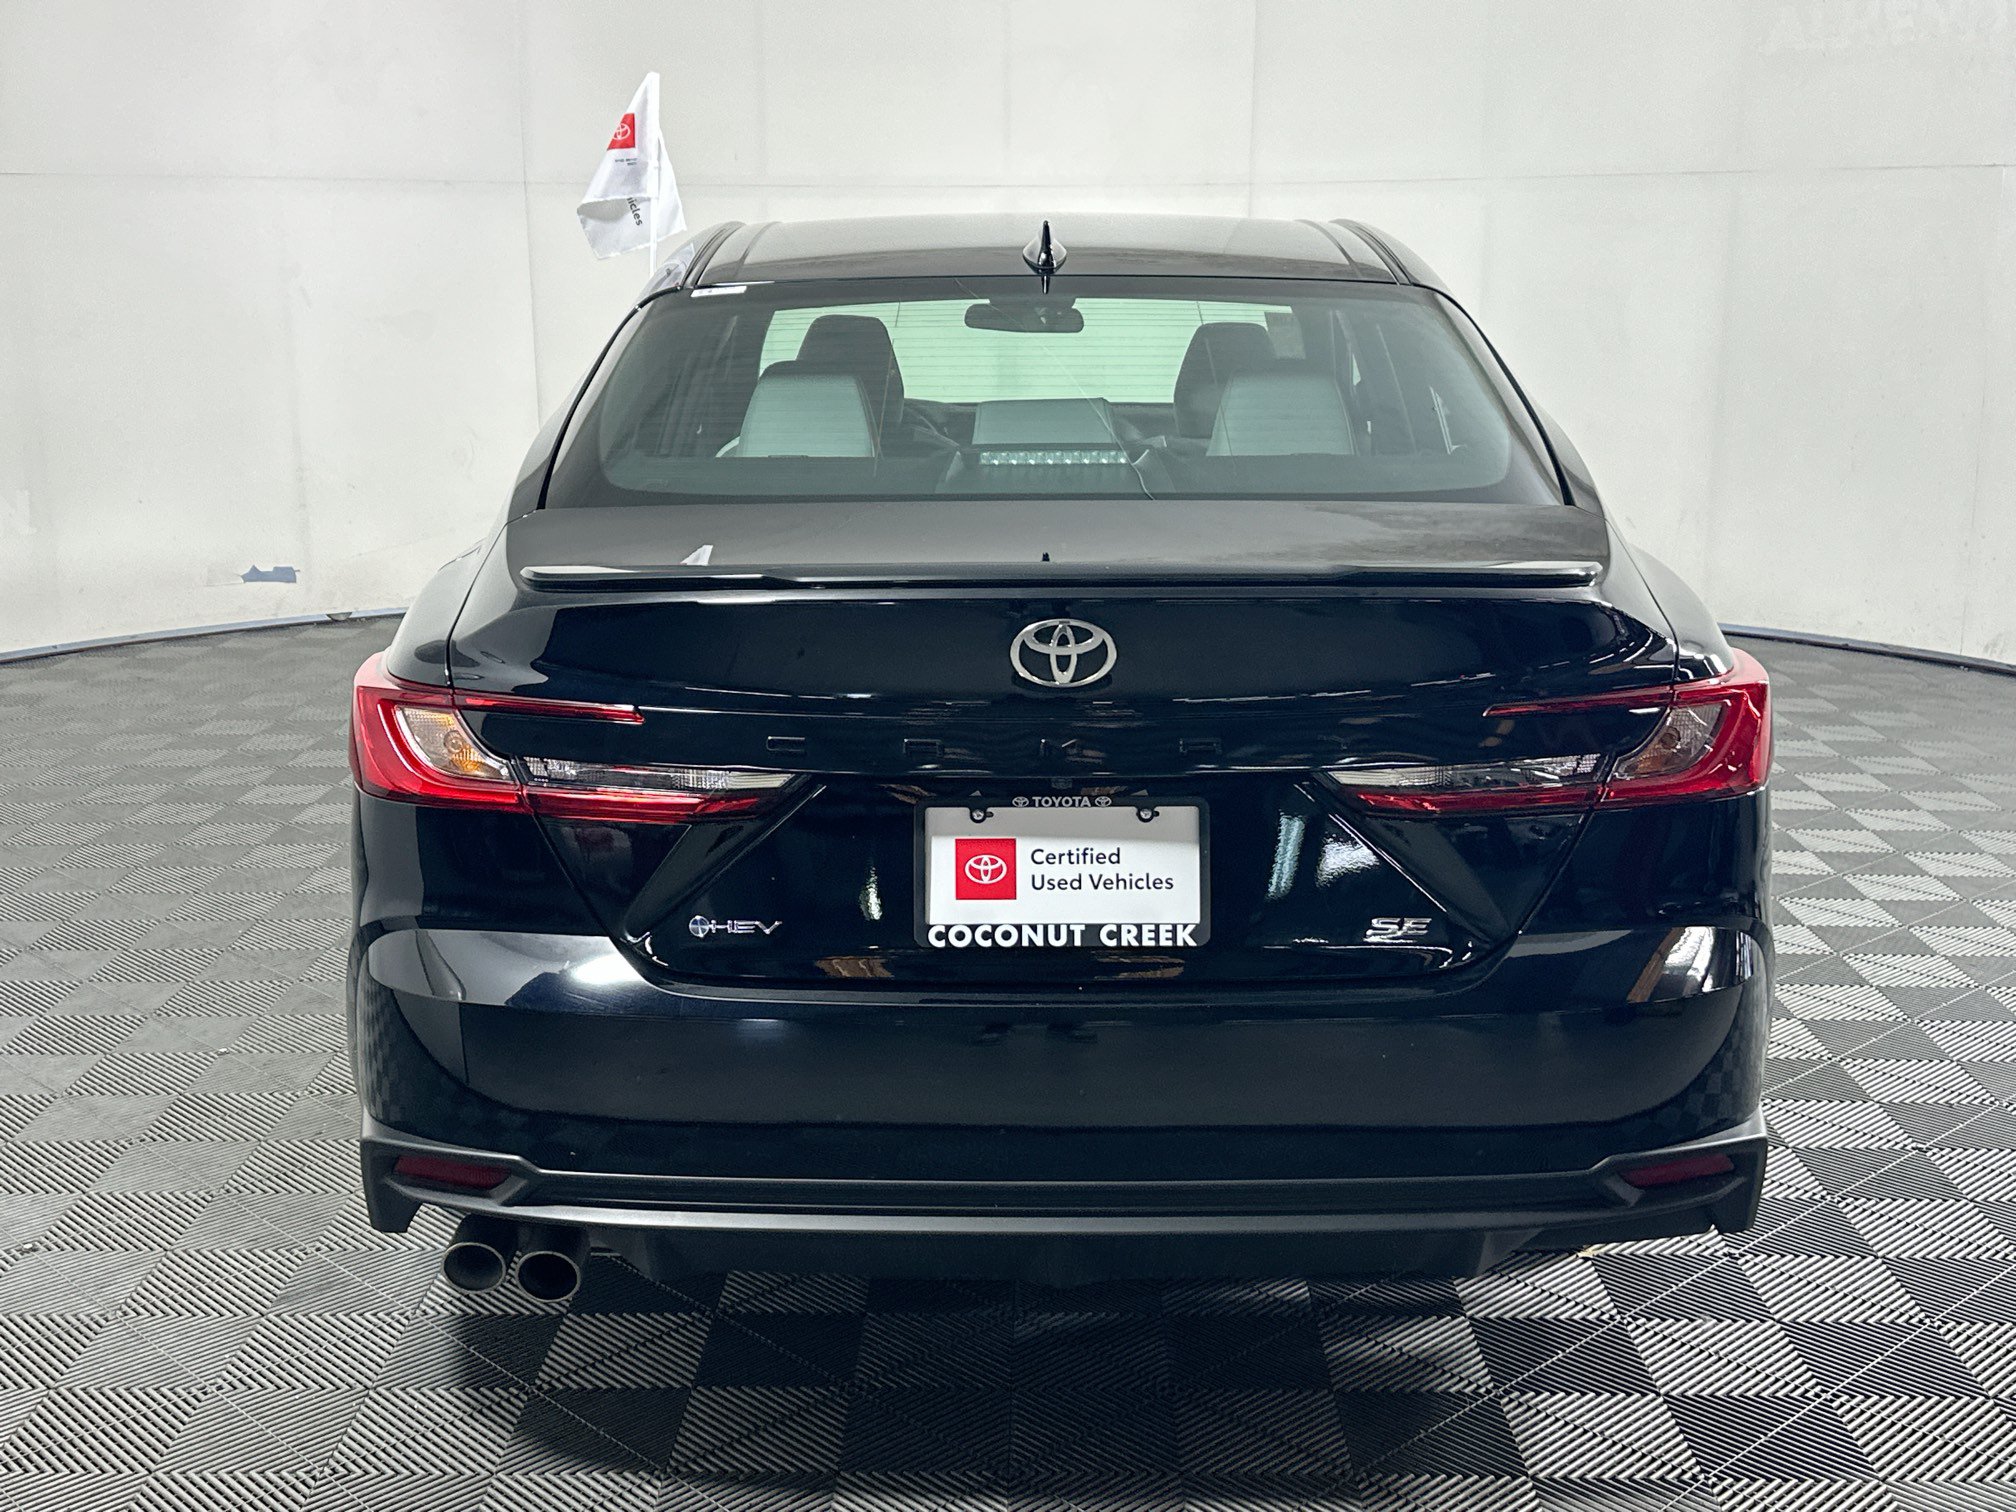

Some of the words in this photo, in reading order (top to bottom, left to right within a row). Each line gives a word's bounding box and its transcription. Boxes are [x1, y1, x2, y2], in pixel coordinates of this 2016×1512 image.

[1032, 796, 1092, 808] TOYOTA
[1030, 847, 1121, 865] Certified
[1030, 873, 1083, 891] Used
[1089, 873, 1174, 891] Vehicles
[711, 919, 783, 935] HEV
[928, 924, 1086, 948] COCONUT
[1099, 924, 1198, 947] CREEK
[1366, 917, 1432, 937] SE
